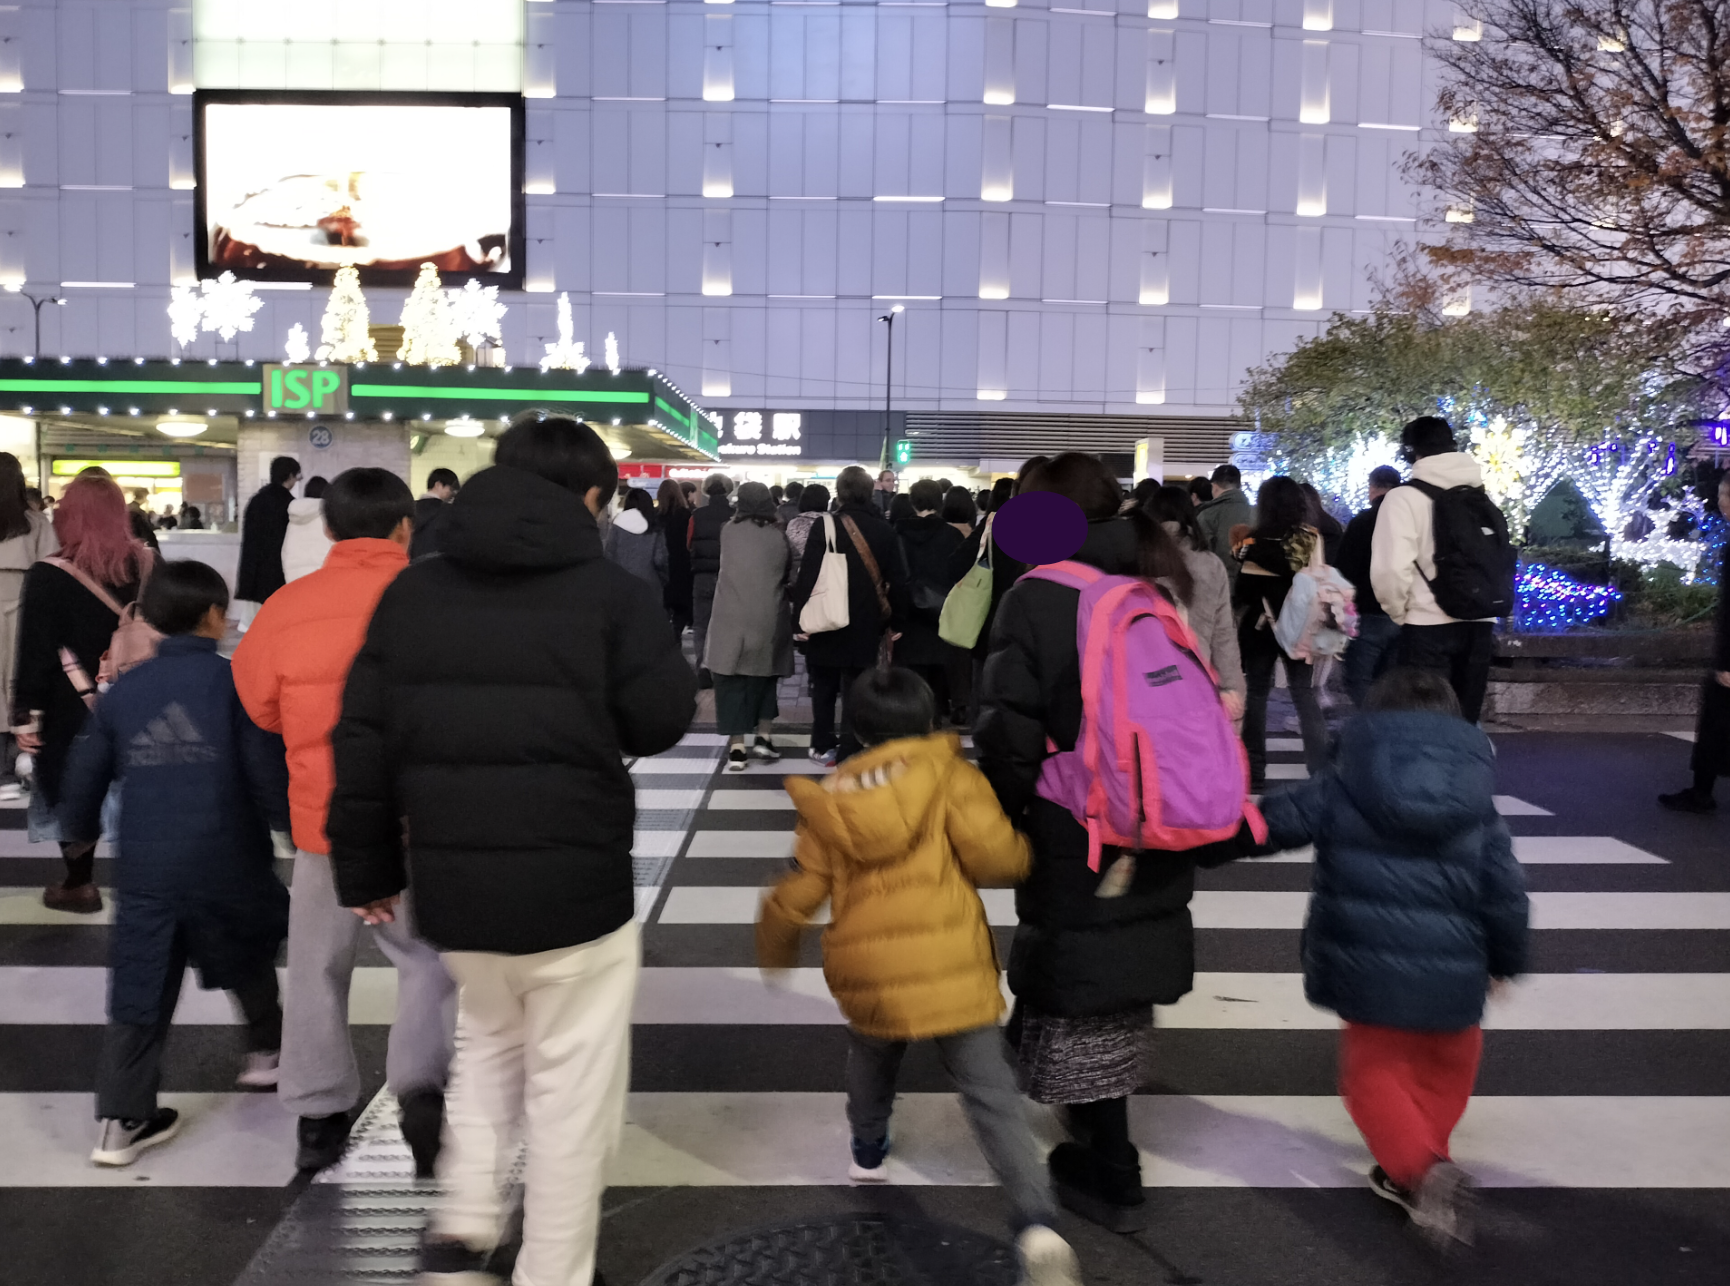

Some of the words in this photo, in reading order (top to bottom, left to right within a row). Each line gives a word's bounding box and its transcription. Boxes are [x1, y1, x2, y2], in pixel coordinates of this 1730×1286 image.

[271, 369, 341, 409] ISP
[311, 429, 330, 445] 28
[757, 443, 802, 455] Station
